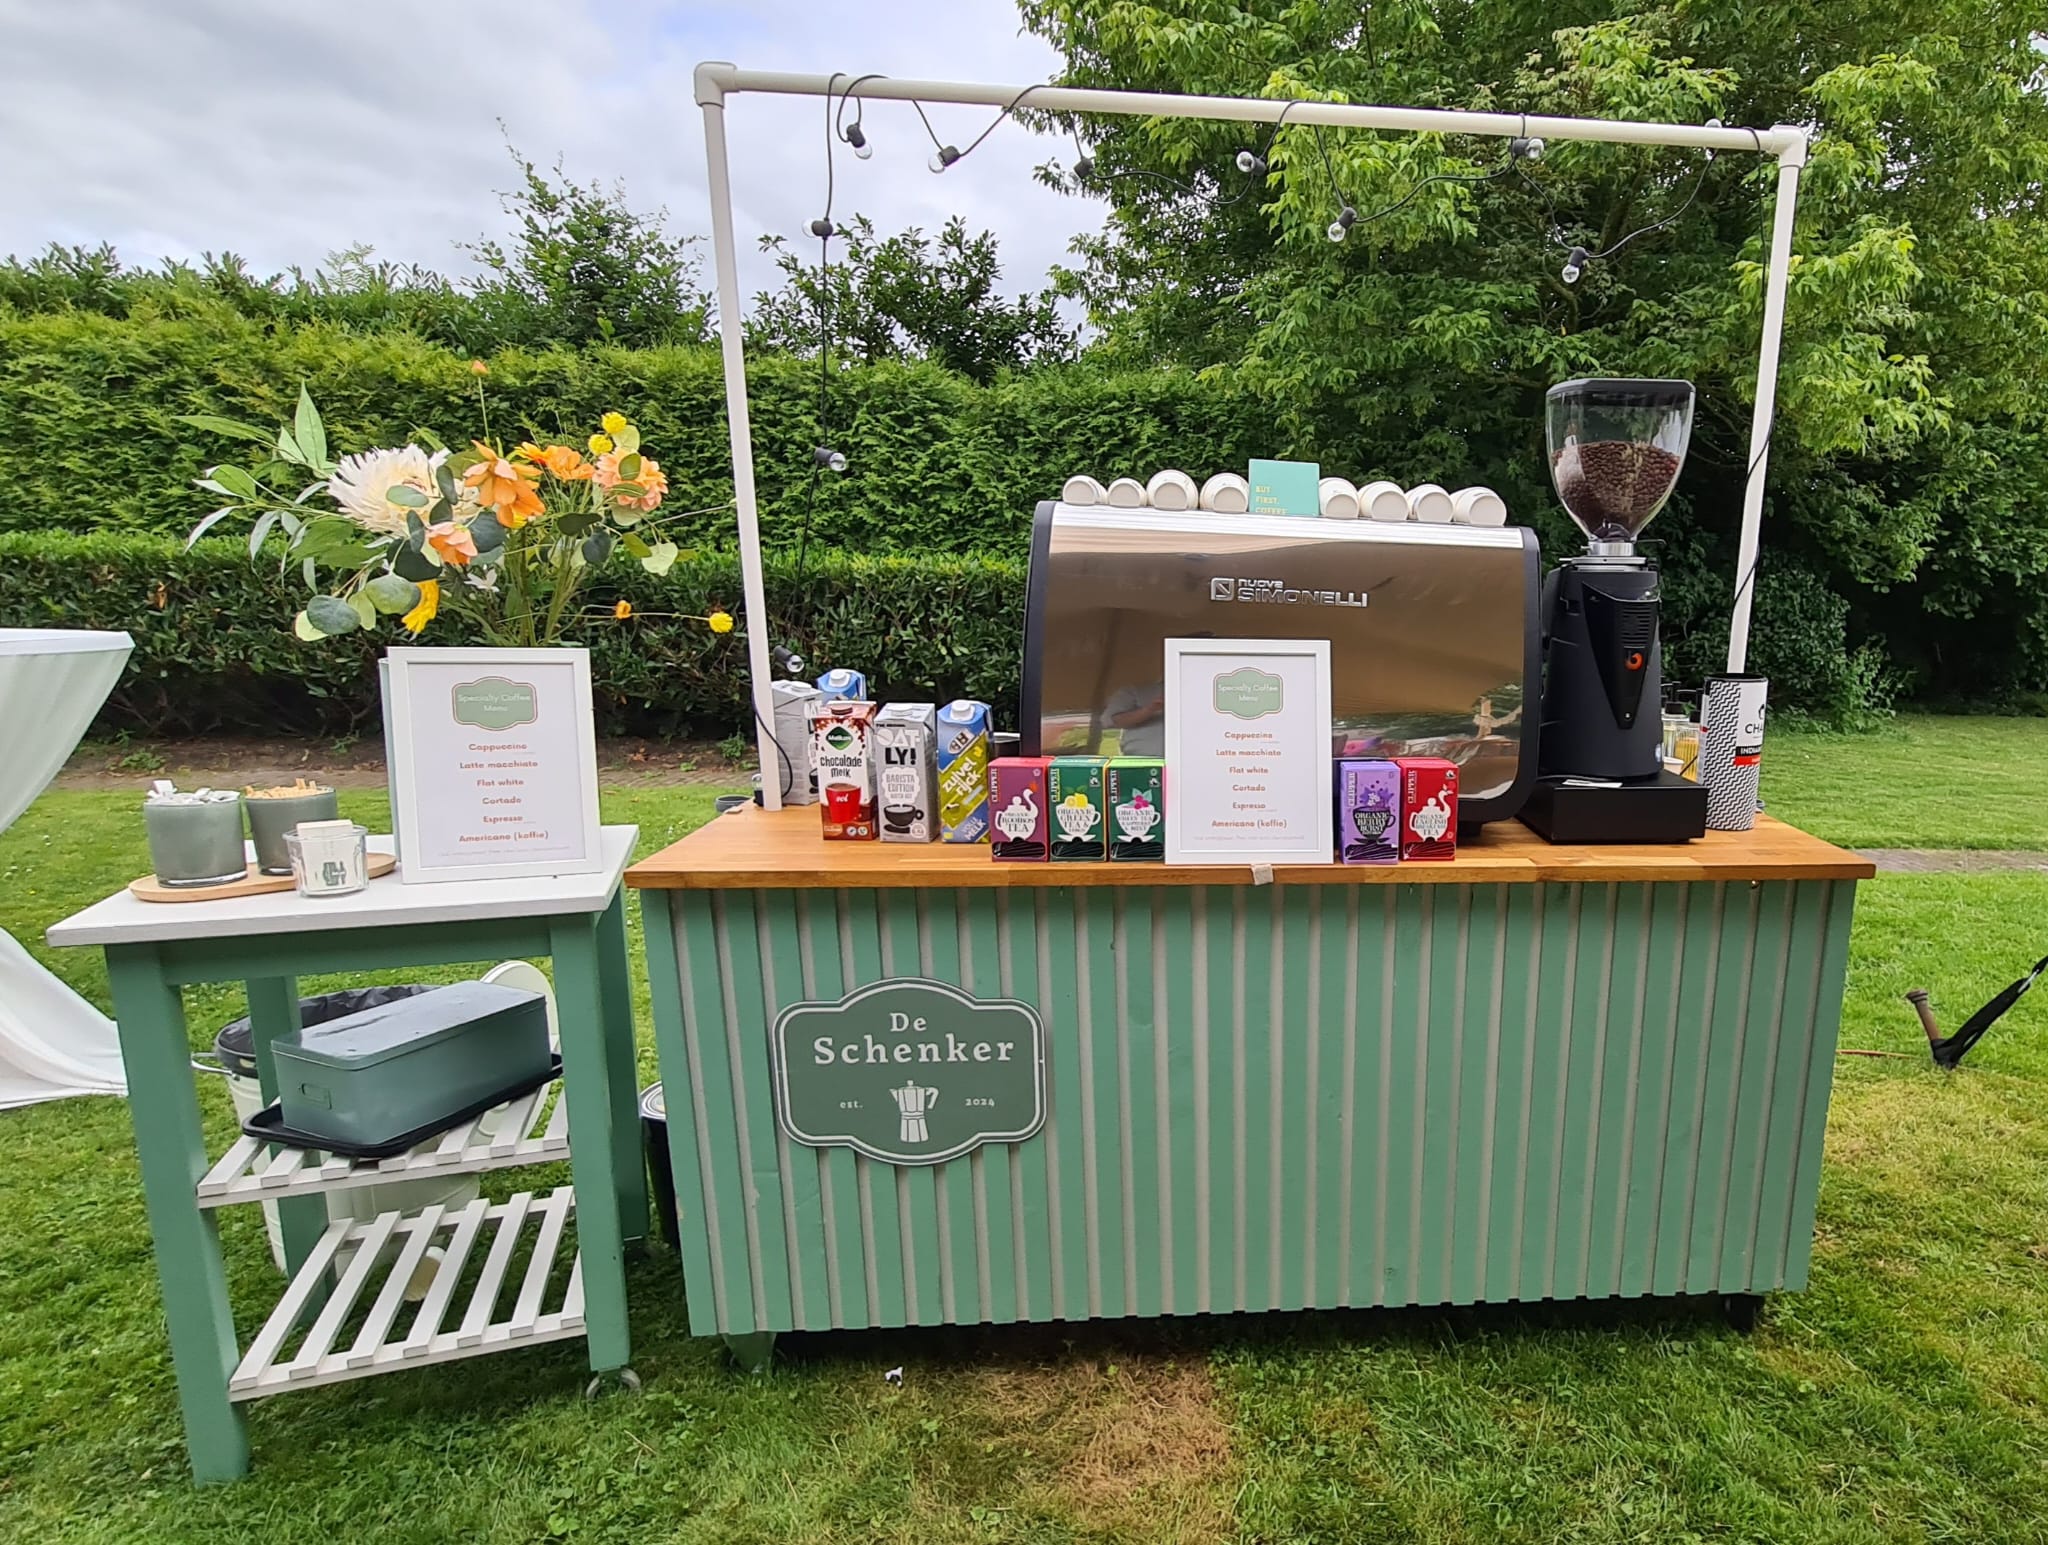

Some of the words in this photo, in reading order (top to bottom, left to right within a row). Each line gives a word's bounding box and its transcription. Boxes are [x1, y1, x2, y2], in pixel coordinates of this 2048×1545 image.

[1237, 588, 1368, 608] SIMONELLI
[1252, 683, 1278, 692] Coffee
[501, 692, 531, 702] Coffee
[483, 704, 508, 712] Menu
[1224, 731, 1273, 740] Cappuccino
[468, 743, 528, 752] Cappuccino
[1238, 748, 1282, 756] macchiato
[820, 755, 862, 767] chocolade
[885, 747, 916, 766] LY!
[487, 759, 538, 768] macchiato
[1229, 766, 1244, 774] Flat
[1246, 765, 1268, 774] white
[477, 778, 495, 786] Flat
[498, 777, 524, 785] white
[885, 774, 915, 783] BARISTA
[887, 783, 914, 792] EDITION
[482, 796, 521, 804] Cortado
[1232, 802, 1266, 811] Espresso
[483, 815, 523, 824] Espresso
[1257, 819, 1287, 829] (koffie)
[964, 819, 986, 840] MELK
[1008, 823, 1029, 832] TEA
[459, 834, 511, 842] Americano
[513, 830, 549, 841] (koffie)
[890, 1012, 927, 1032] De
[814, 1033, 1014, 1065] Schenker
[840, 1099, 864, 1109] est.
[965, 1097, 995, 1108] 2024
